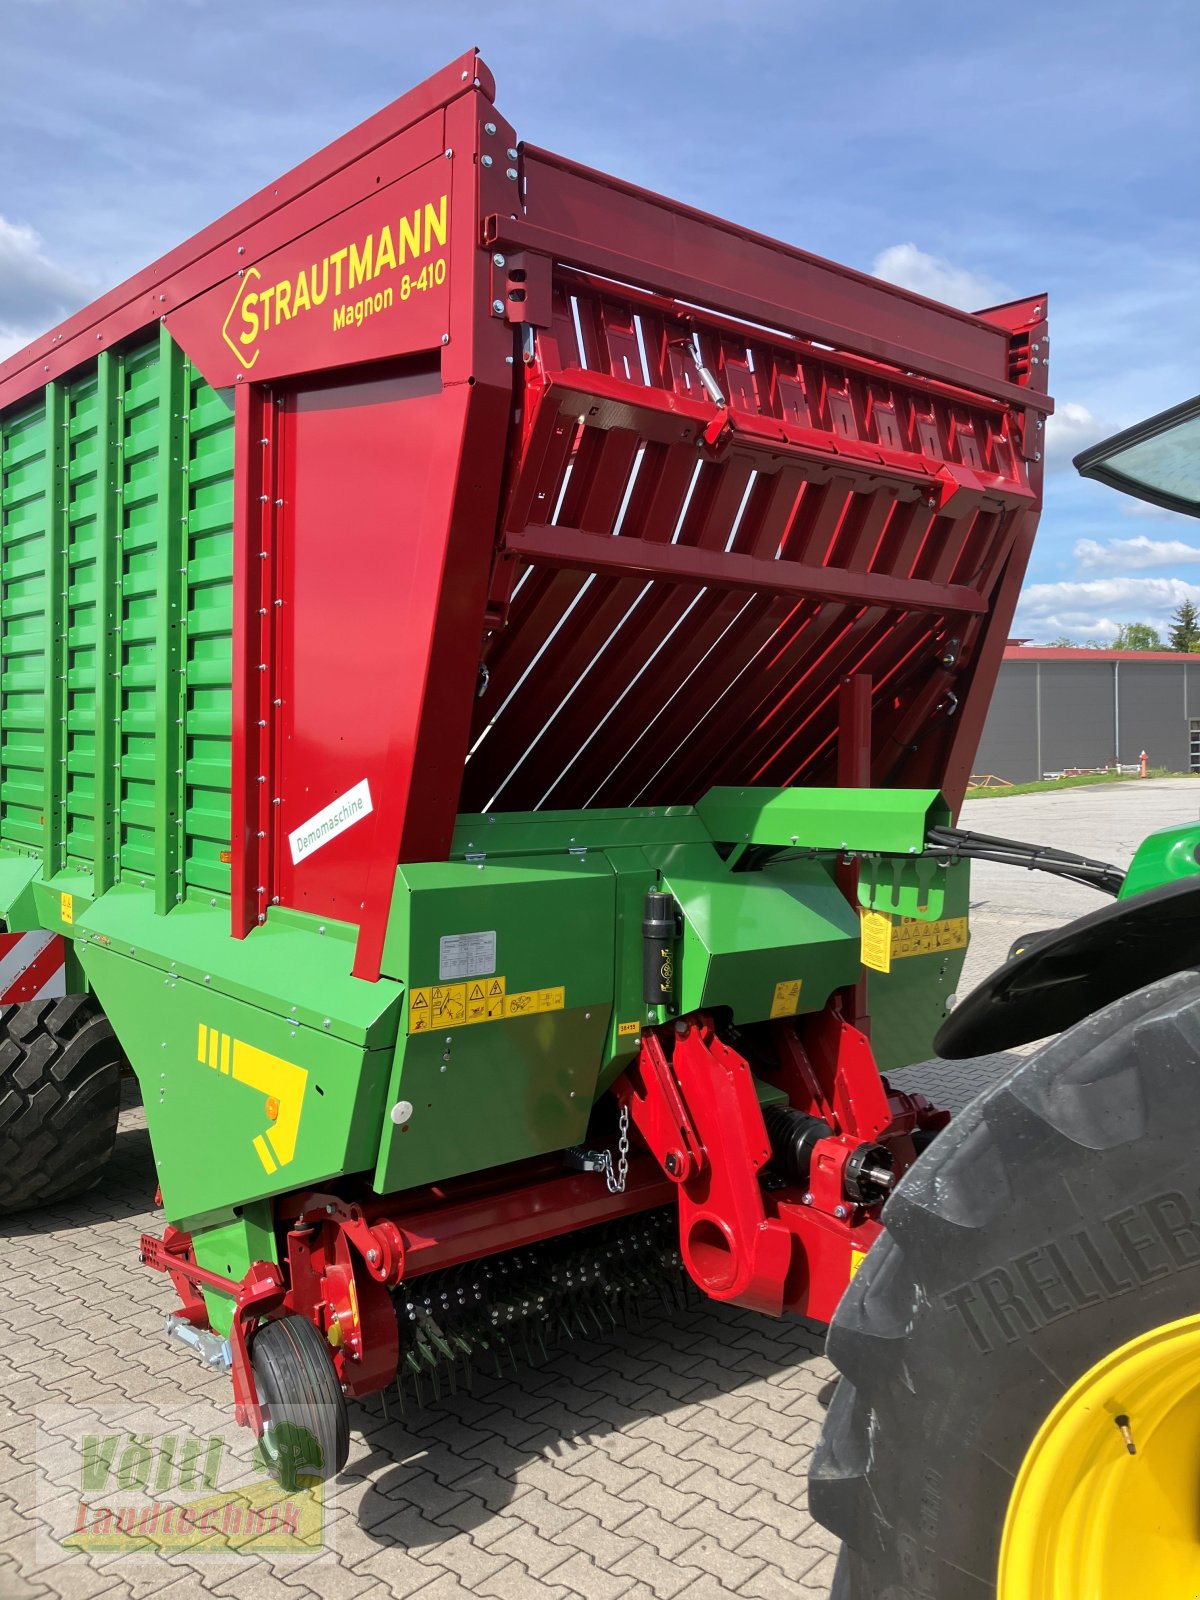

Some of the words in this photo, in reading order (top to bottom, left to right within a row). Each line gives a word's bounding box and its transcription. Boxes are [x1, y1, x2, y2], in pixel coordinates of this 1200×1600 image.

[240, 194, 447, 345] STRAUTMANN
[333, 287, 393, 332] Magnon
[400, 258, 446, 301] 8-410
[296, 797, 364, 853] Demomaschine
